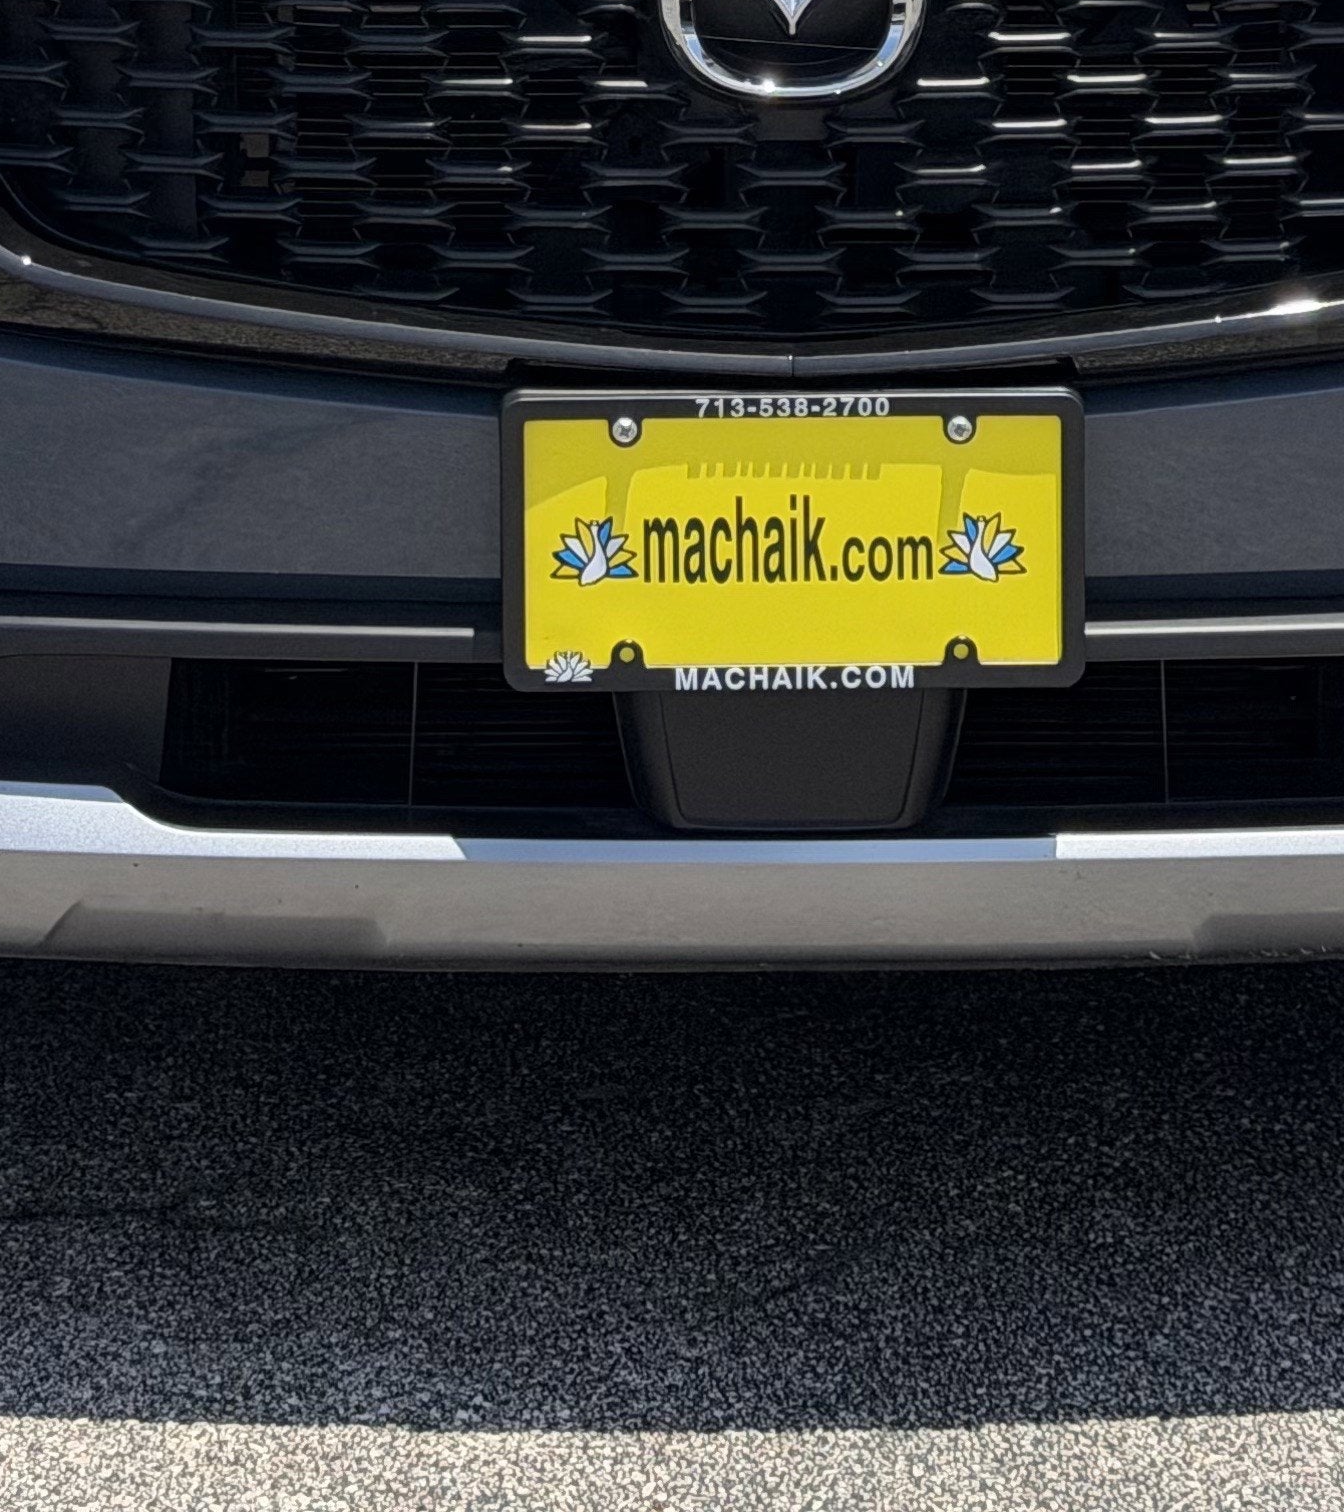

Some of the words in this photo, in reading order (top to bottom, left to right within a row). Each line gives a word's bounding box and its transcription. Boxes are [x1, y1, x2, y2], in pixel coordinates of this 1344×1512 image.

[695, 397, 891, 419] 713-538-2700
[642, 494, 934, 585] machaik.com
[674, 664, 916, 692] MACHAIK.COM
